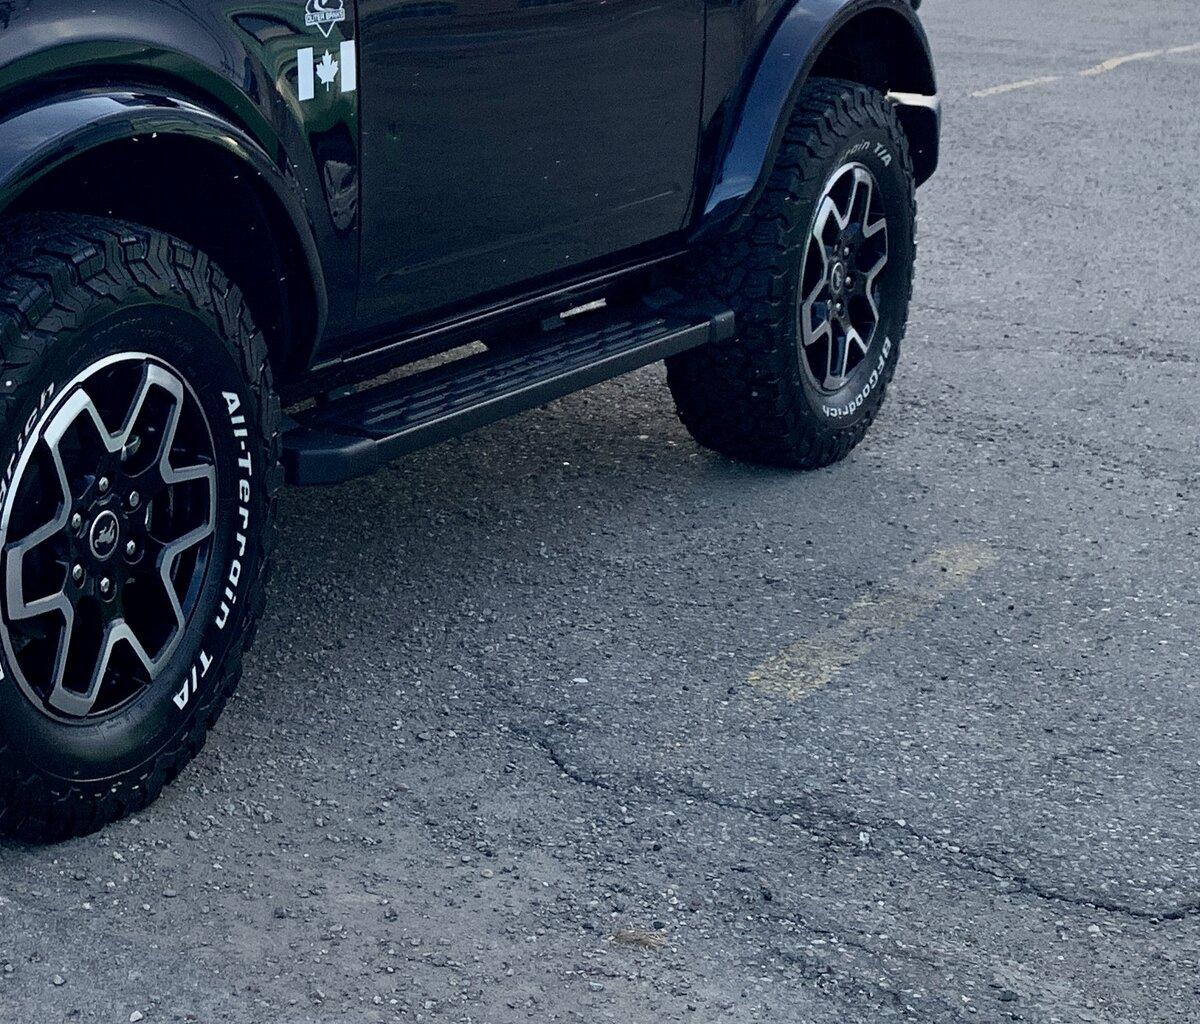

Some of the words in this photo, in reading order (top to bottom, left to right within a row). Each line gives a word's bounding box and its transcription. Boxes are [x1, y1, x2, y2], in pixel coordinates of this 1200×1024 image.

[822, 337, 891, 417] BFGoodrich
[215, 391, 252, 630] All-Terrain
[172, 650, 213, 710] T/A
